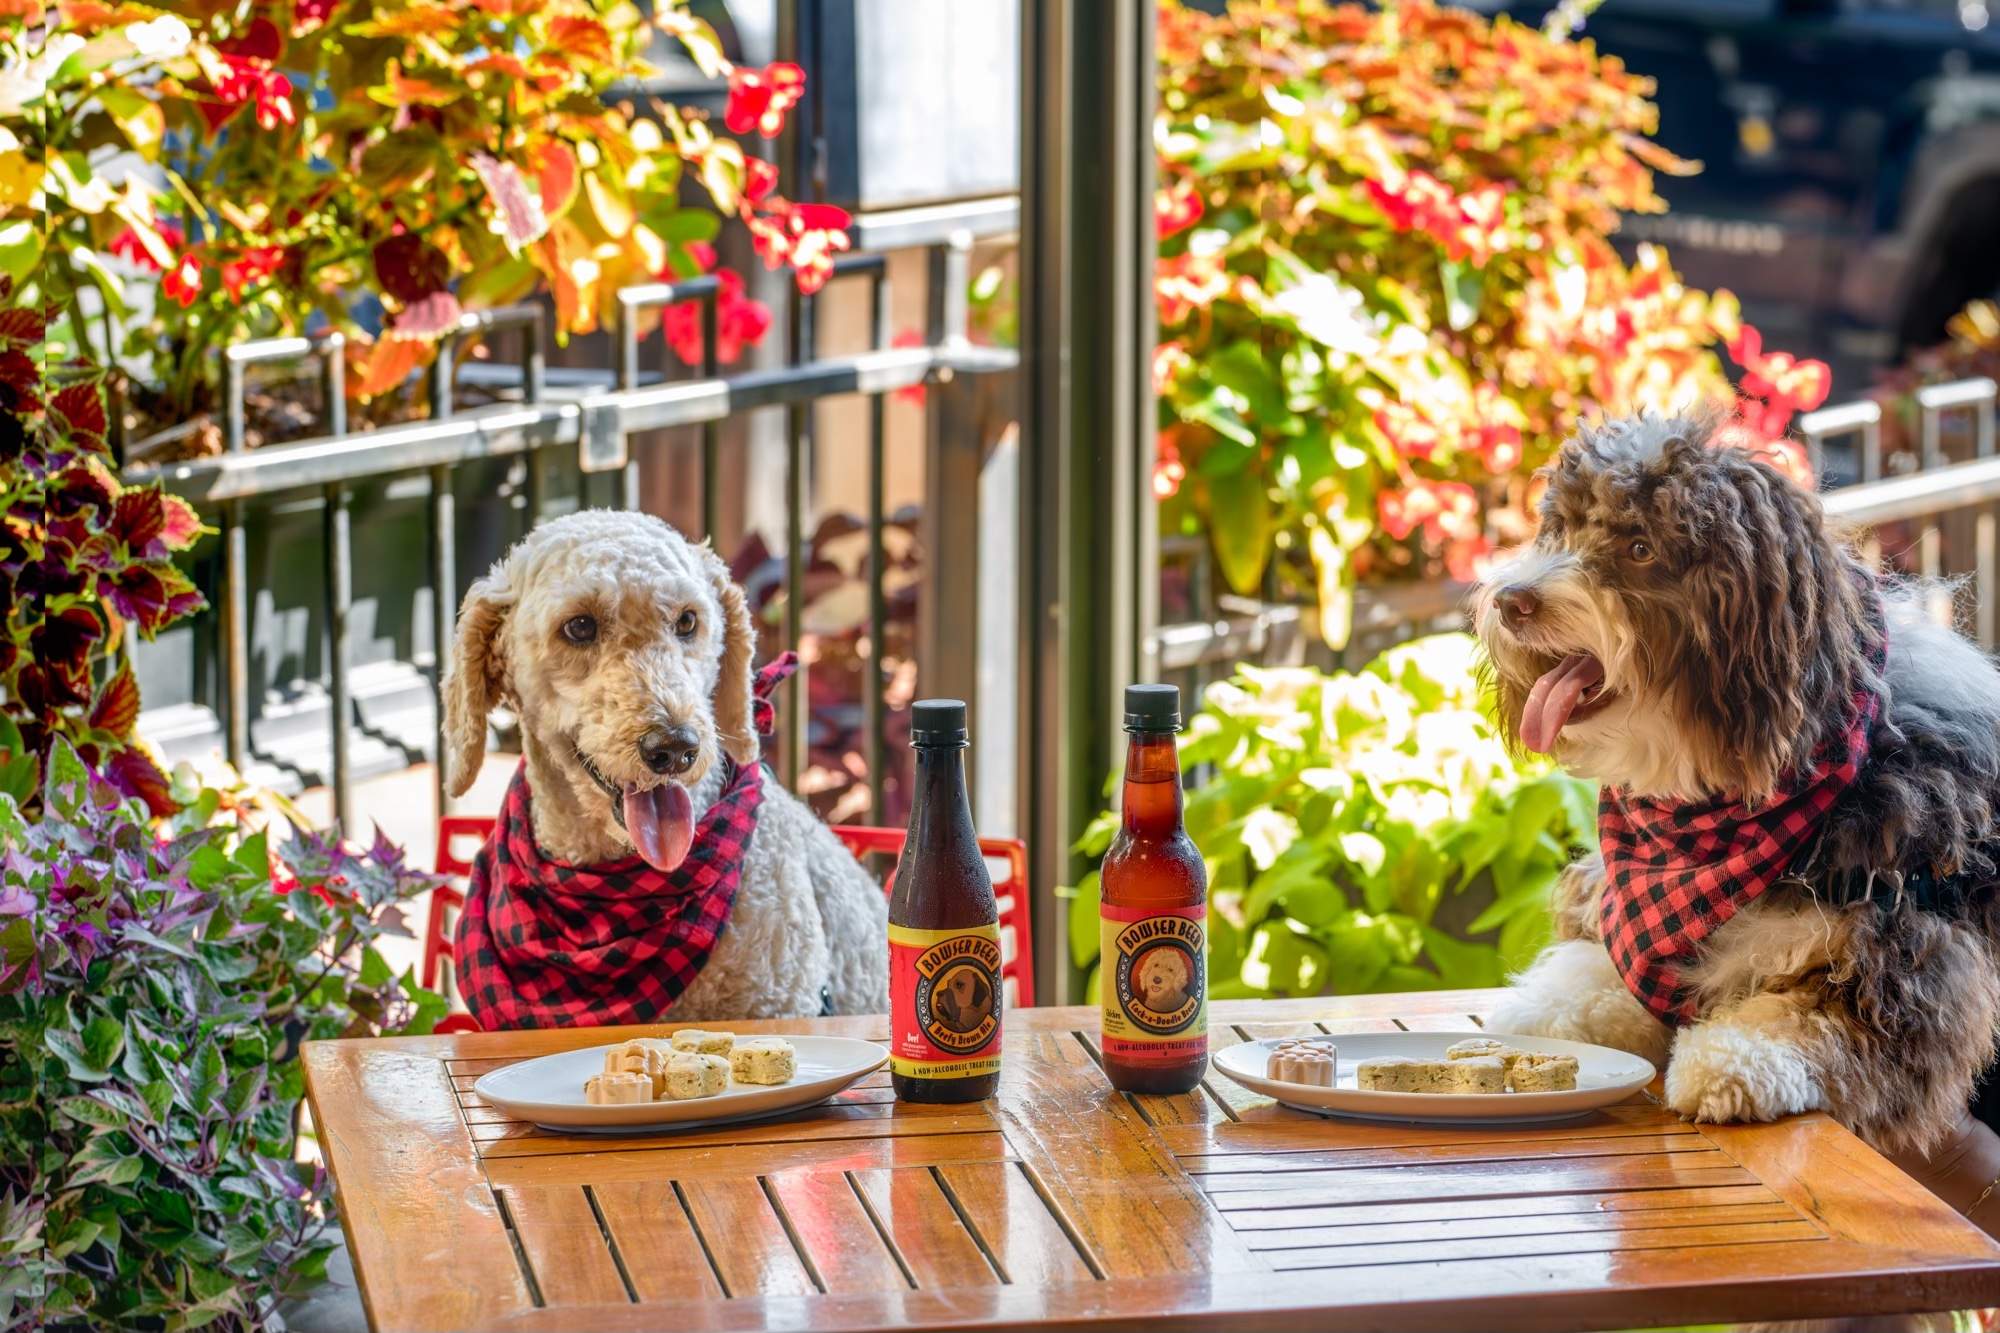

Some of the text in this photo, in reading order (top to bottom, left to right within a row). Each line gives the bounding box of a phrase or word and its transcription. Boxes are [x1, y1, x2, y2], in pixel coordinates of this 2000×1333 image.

[1122, 919, 1201, 950] BOWSER BEER
[921, 939, 999, 973] BOWSER BEER
[1130, 1002, 1182, 1025] Cock-a-Doodle
[1180, 1001, 1196, 1018] Brew
[907, 1031, 919, 1043] Beef
[934, 1021, 992, 1046] Beefy Brown Ale
[918, 1063, 968, 1075] NON-ALCOHOLIC
[969, 1061, 985, 1070] TREAT
